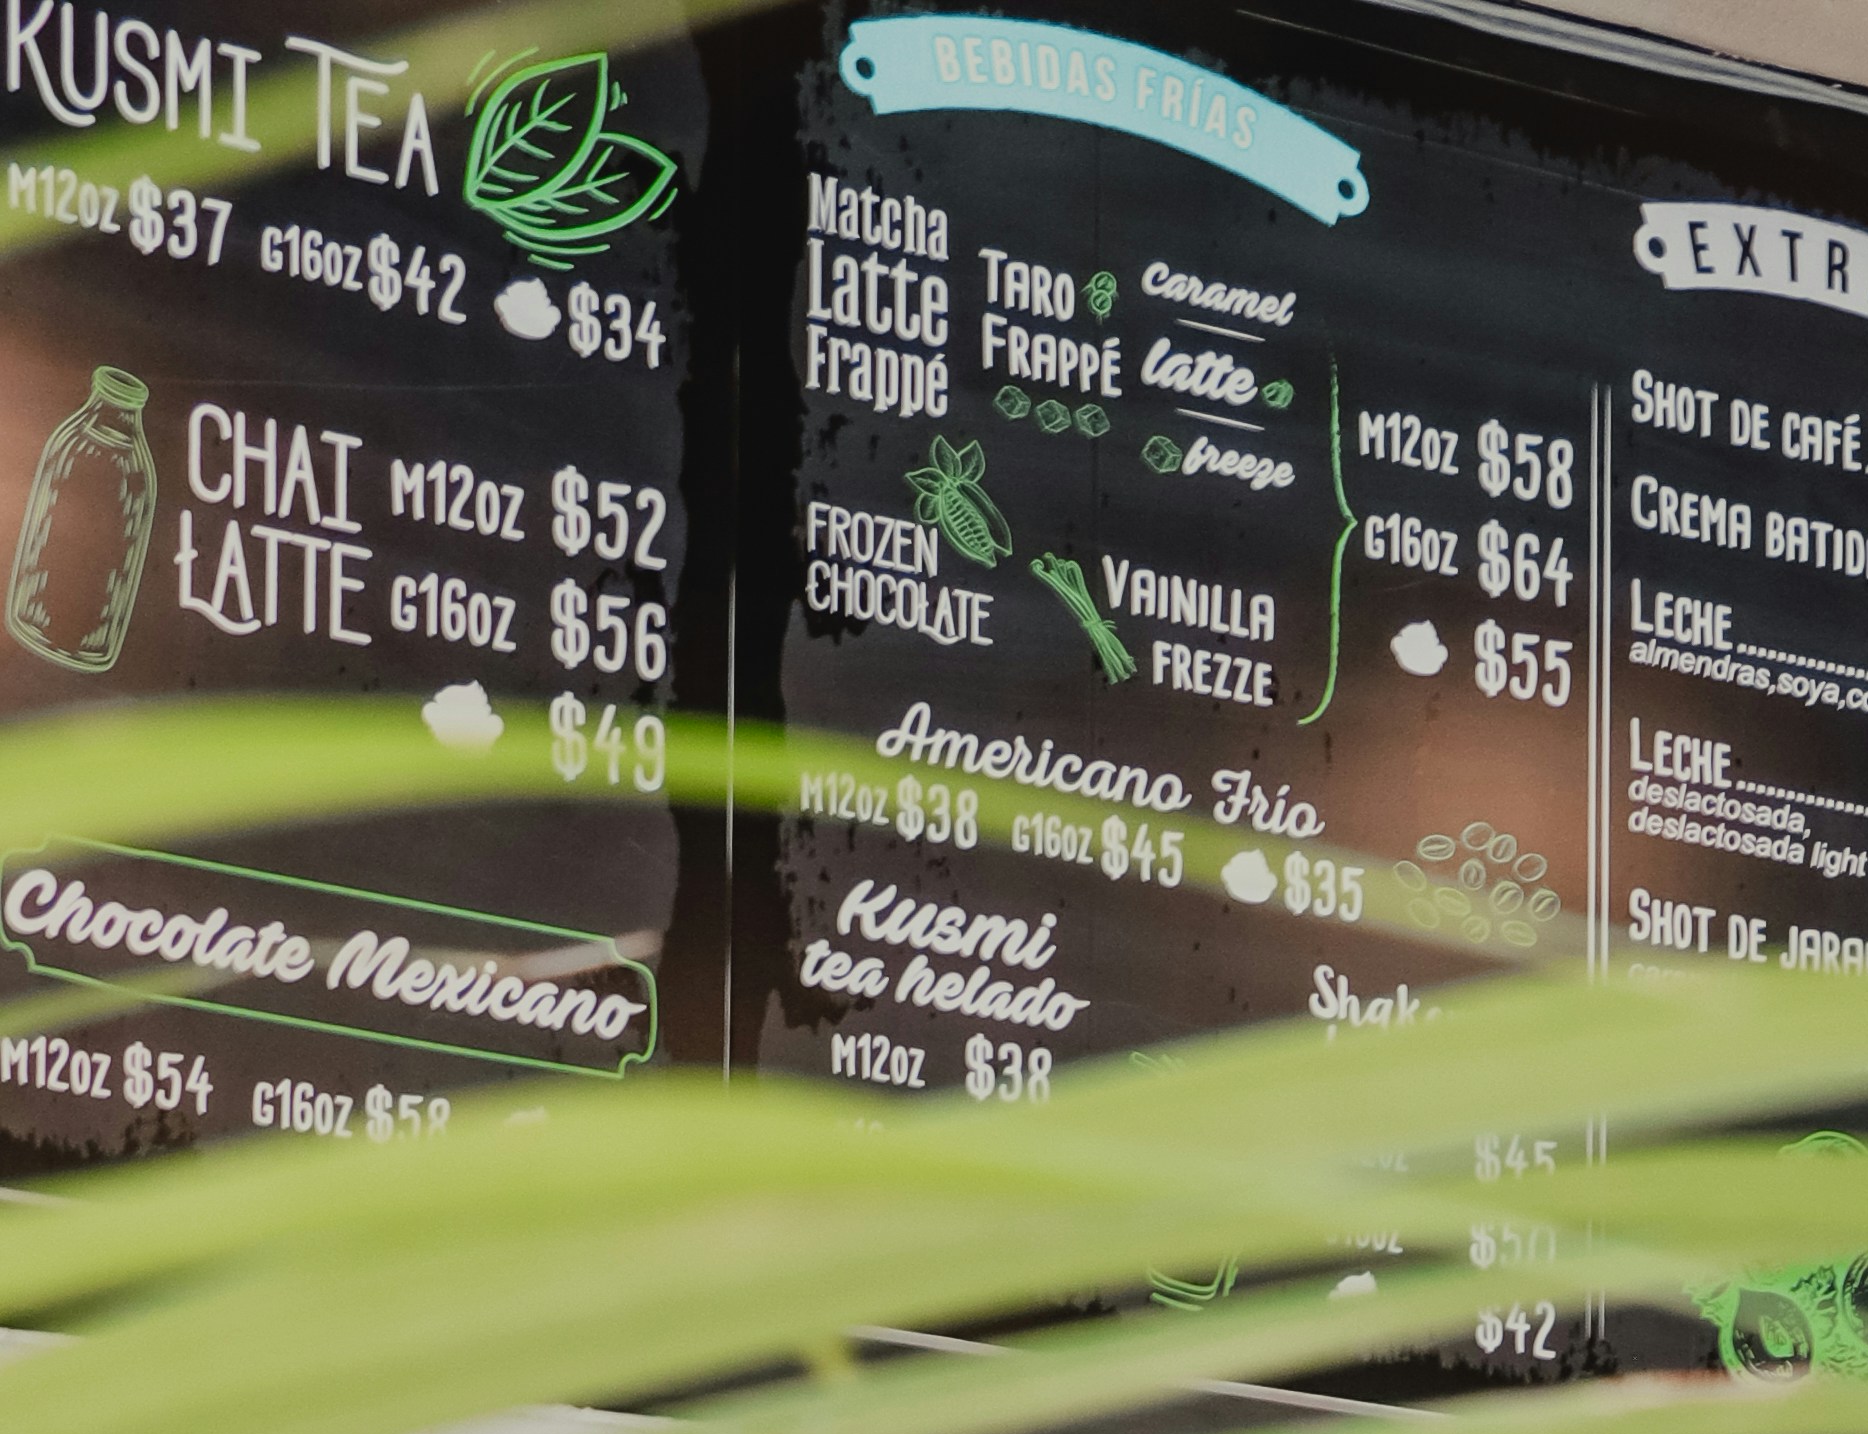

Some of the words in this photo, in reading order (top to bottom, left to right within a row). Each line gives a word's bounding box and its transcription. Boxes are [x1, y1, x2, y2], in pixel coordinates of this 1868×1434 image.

[7, 0, 262, 151] KUSMI
[285, 36, 438, 196] TEA
[935, 36, 1115, 101] BEBIDAS
[1137, 67, 1258, 149] FRÍAS
[806, 172, 948, 261] Matcha
[128, 175, 232, 265] $37
[368, 234, 467, 323] $42
[568, 282, 666, 368] $34
[807, 239, 948, 347] Latte
[978, 248, 1075, 321] TARO
[806, 324, 948, 417] Frappé
[981, 313, 1122, 397] FRAPPÉ
[1141, 337, 1258, 406] latte
[1631, 370, 1719, 437] SHOT
[1730, 401, 1770, 449] DE
[189, 403, 362, 532] CHAI
[1182, 436, 1296, 491] freeze
[1477, 420, 1574, 510] $58
[552, 466, 667, 569] $52
[806, 501, 938, 578] FROZEN
[1630, 474, 1752, 549] CREMA
[174, 510, 372, 644] LATTE
[806, 560, 993, 645] CHOCOLATE
[1101, 555, 1275, 641] VAINILLA
[1477, 520, 1574, 606] $64
[551, 579, 667, 681] $56
[1153, 641, 1273, 706] FREZZE
[1474, 620, 1573, 707] $55
[549, 691, 666, 792] $49
[877, 702, 1192, 812] Americano
[1211, 768, 1326, 839] Frío
[896, 776, 978, 849] $38
[1100, 814, 1184, 887] $45
[1284, 851, 1365, 922] $35
[1628, 775, 1811, 840] deslactosada,
[1628, 806, 1805, 864] deslactosada
[1810, 841, 1868, 878] light
[3, 869, 315, 982] Chocolate
[326, 929, 647, 1039] Mexicano
[837, 879, 1057, 971] Kusmi
[1629, 888, 1716, 953] SHOT
[1728, 914, 1767, 962] DE
[800, 940, 889, 998] tea
[895, 954, 1090, 1031] helado
[123, 1042, 213, 1116] $54
[965, 1034, 1052, 1101] $38
[1475, 1302, 1556, 1361] $42
